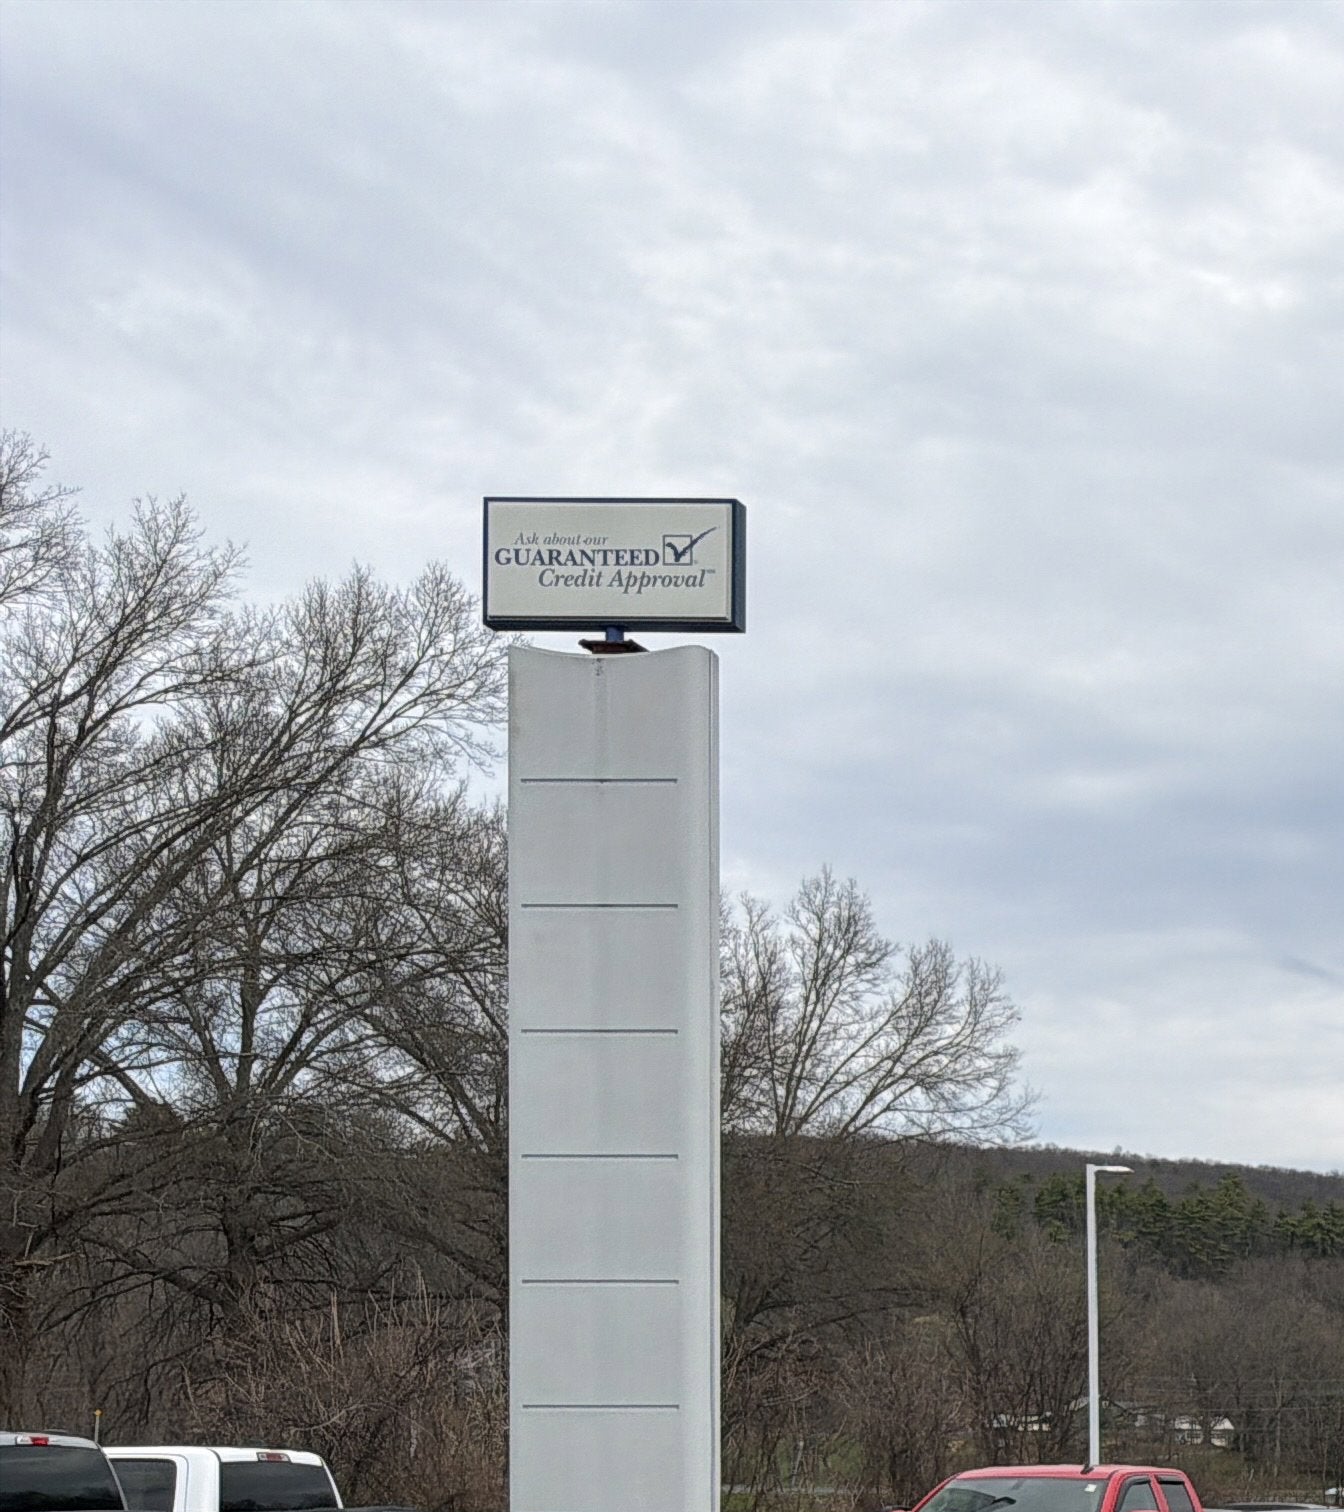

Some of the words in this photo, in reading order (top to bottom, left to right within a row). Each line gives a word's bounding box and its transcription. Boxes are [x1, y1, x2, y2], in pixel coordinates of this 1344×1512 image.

[514, 532, 537, 546] Ask
[543, 532, 583, 546] about
[585, 536, 608, 546] our
[494, 548, 660, 566] GUARANTEED
[538, 568, 602, 588] Credit
